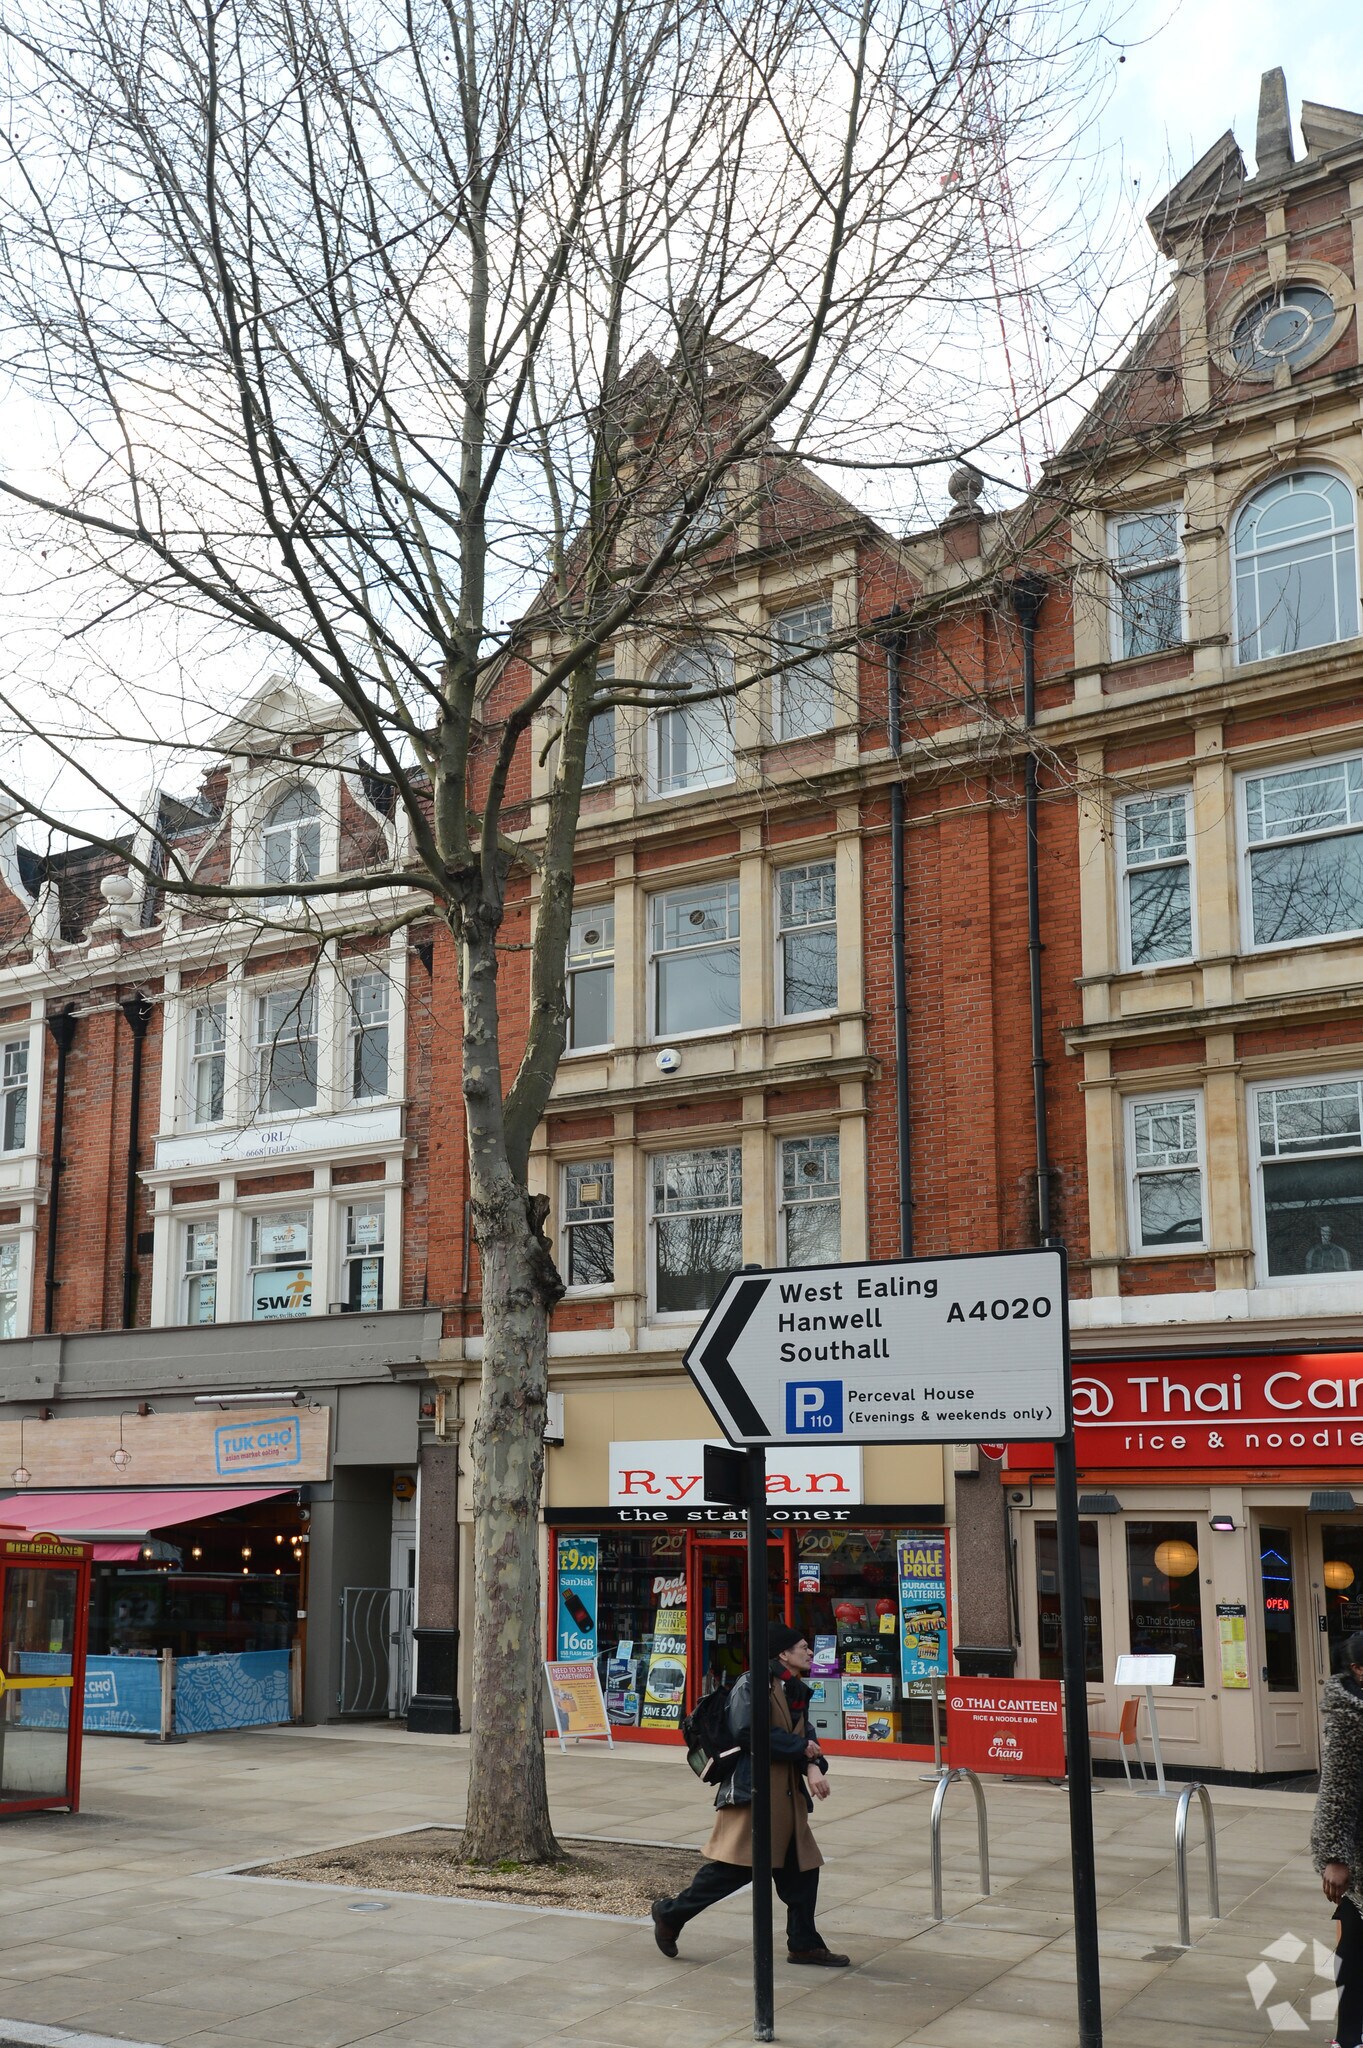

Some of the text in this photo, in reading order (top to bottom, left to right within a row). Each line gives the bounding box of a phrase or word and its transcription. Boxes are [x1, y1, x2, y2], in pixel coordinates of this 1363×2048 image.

[779, 1276, 938, 1304] West Ealing
[946, 1296, 1052, 1323] A4020
[778, 1307, 883, 1333] Hanwell
[779, 1338, 890, 1363] Southall
[848, 1387, 975, 1403] Perceval House
[1127, 1373, 1242, 1413] Thai
[795, 1387, 825, 1428] P
[848, 1406, 1053, 1424] (Evenings & weekends only)
[810, 1414, 833, 1428] 110
[223, 1435, 255, 1454] TUK
[1125, 1432, 1187, 1450] rice
[1207, 1431, 1225, 1449] &
[225, 1448, 280, 1462] asian market eating
[618, 1470, 851, 1501] Ryan
[617, 1508, 851, 1521] the statoner
[12, 1542, 79, 1556] TELEPHONE
[903, 1549, 943, 1564] HALF
[560, 1548, 596, 1571] £9.99
[903, 1563, 943, 1577] PRICE
[560, 1577, 594, 1586] SanDisk
[653, 1572, 686, 1594] Deal
[901, 1582, 945, 1590] DURACELL
[660, 1590, 687, 1609] Wee
[902, 1589, 946, 1599] BATTERIES
[1266, 1598, 1290, 1610] OPEN
[1146, 1615, 1162, 1625] Thai
[1163, 1616, 1196, 1627] Canteen
[560, 1631, 594, 1650] 16GB
[653, 1637, 687, 1655] £69.99
[643, 1704, 679, 1717] SAVE £20
[951, 1697, 1058, 1712] @ THAI CANTEEN
[988, 1746, 1024, 1761] Chang
